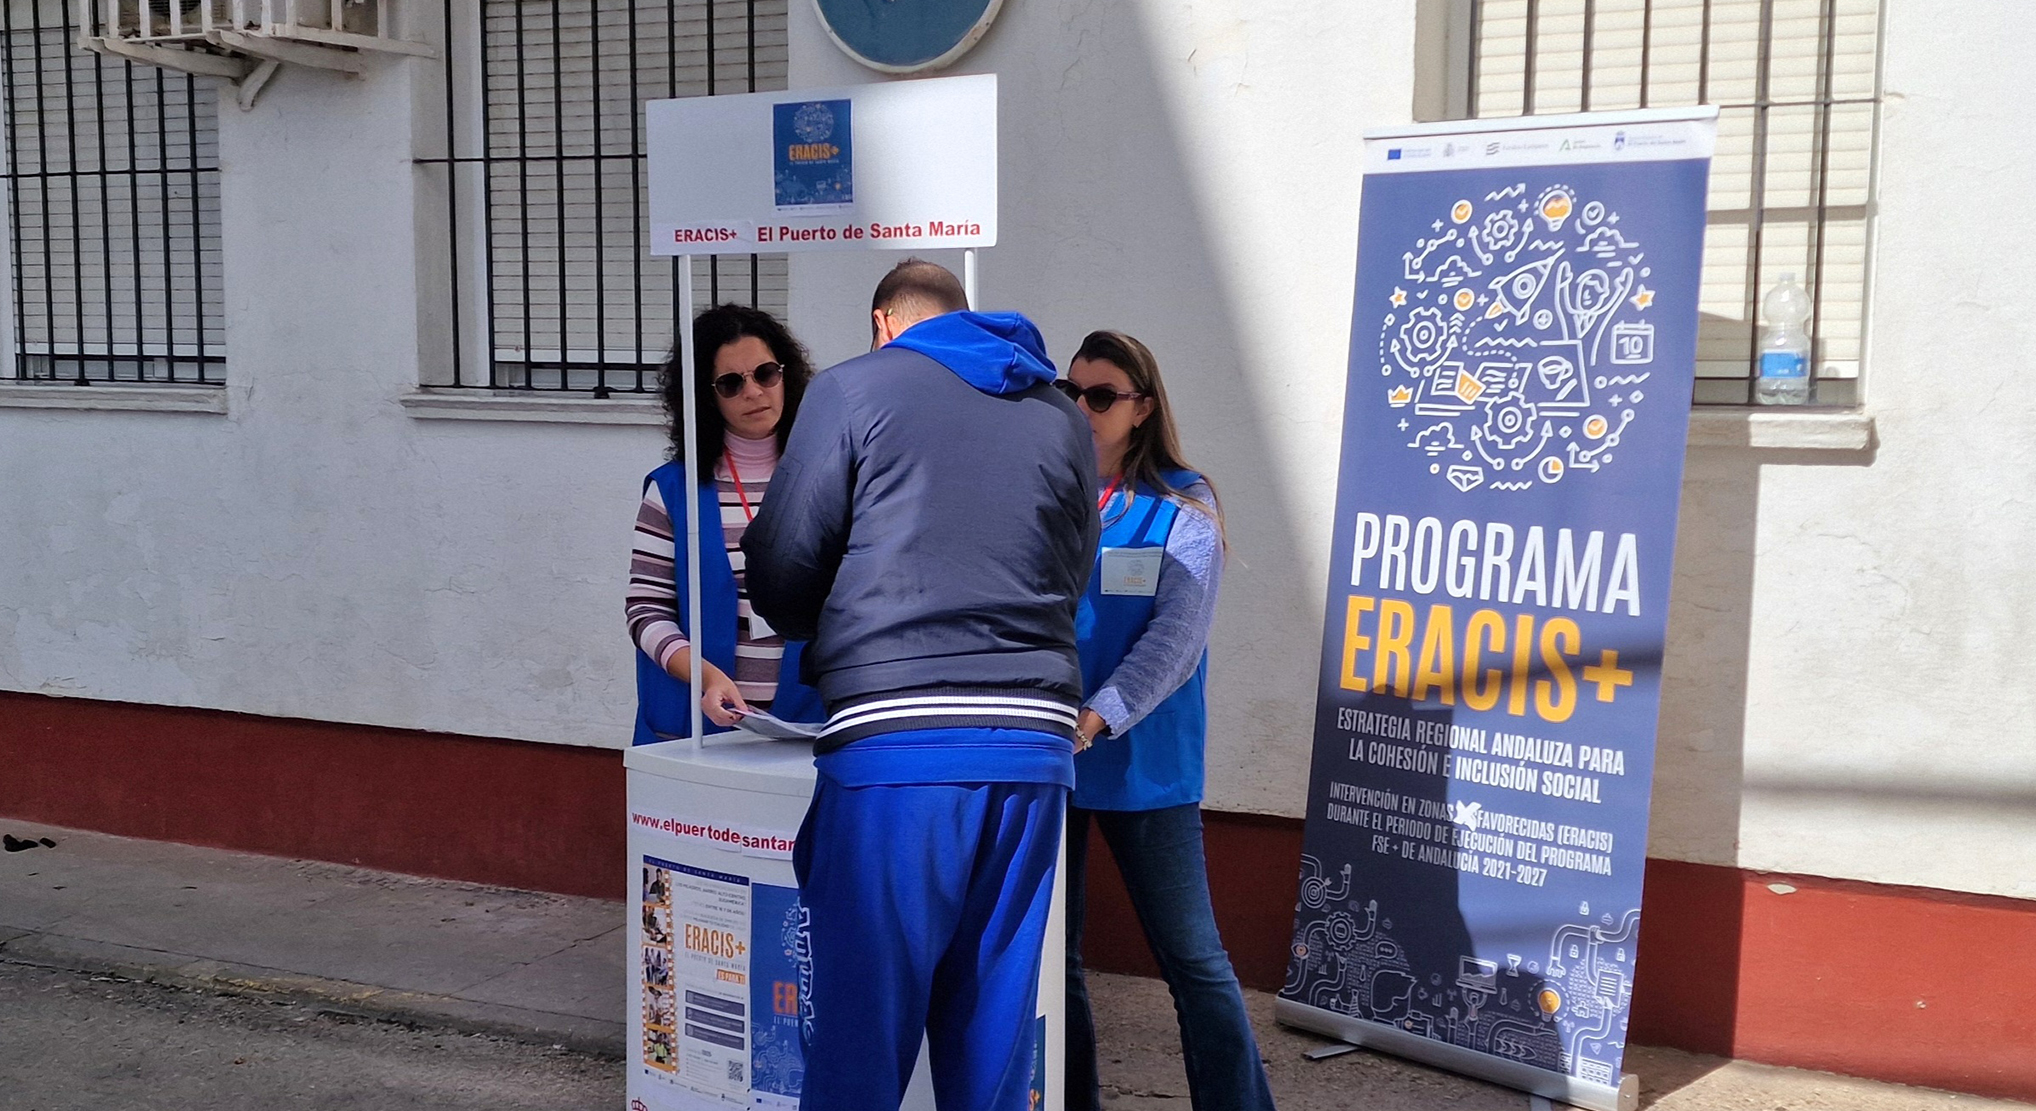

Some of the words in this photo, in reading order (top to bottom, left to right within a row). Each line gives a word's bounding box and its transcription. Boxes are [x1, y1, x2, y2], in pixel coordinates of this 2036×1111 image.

[674, 227, 737, 243] ERACIS+
[757, 226, 773, 242] El
[779, 224, 837, 241] Puerto
[842, 224, 864, 239] de
[870, 222, 922, 239] Santa
[929, 219, 981, 237] María
[1350, 512, 1641, 616] PROGRAMA
[1339, 595, 1634, 724] ERACIS+
[1337, 707, 1411, 741] ESTRATEGIA
[1415, 720, 1488, 754] REGIONAL
[1490, 732, 1574, 768] ANDALUZA
[1578, 745, 1625, 776] PARA
[1348, 737, 1364, 762] LA
[1368, 741, 1440, 775] COHESIÓN
[1442, 754, 1451, 778] E
[1454, 755, 1539, 793] INCLUSIÓN
[1541, 770, 1602, 804] SOCIAL
[1327, 802, 1370, 828] DURANTE
[1372, 812, 1383, 831] EL
[1385, 815, 1432, 841] PERIODO
[1434, 825, 1448, 844] DE
[1451, 827, 1514, 858] EJECUCIÓN
[1516, 840, 1538, 863] DEL
[1541, 845, 1612, 876] PROGRAMA
[1329, 781, 1399, 811] INTERVENCIÓN
[1401, 795, 1417, 815] EN
[1418, 799, 1455, 822] ZONAS
[1557, 824, 1614, 854] (ERACIS)
[1372, 834, 1390, 855] FSE
[1402, 840, 1415, 860] DE
[1417, 844, 1480, 874] ANDALUCÍA
[1482, 857, 1548, 887] 2021-2027
[685, 923, 746, 959] ERACIS+
